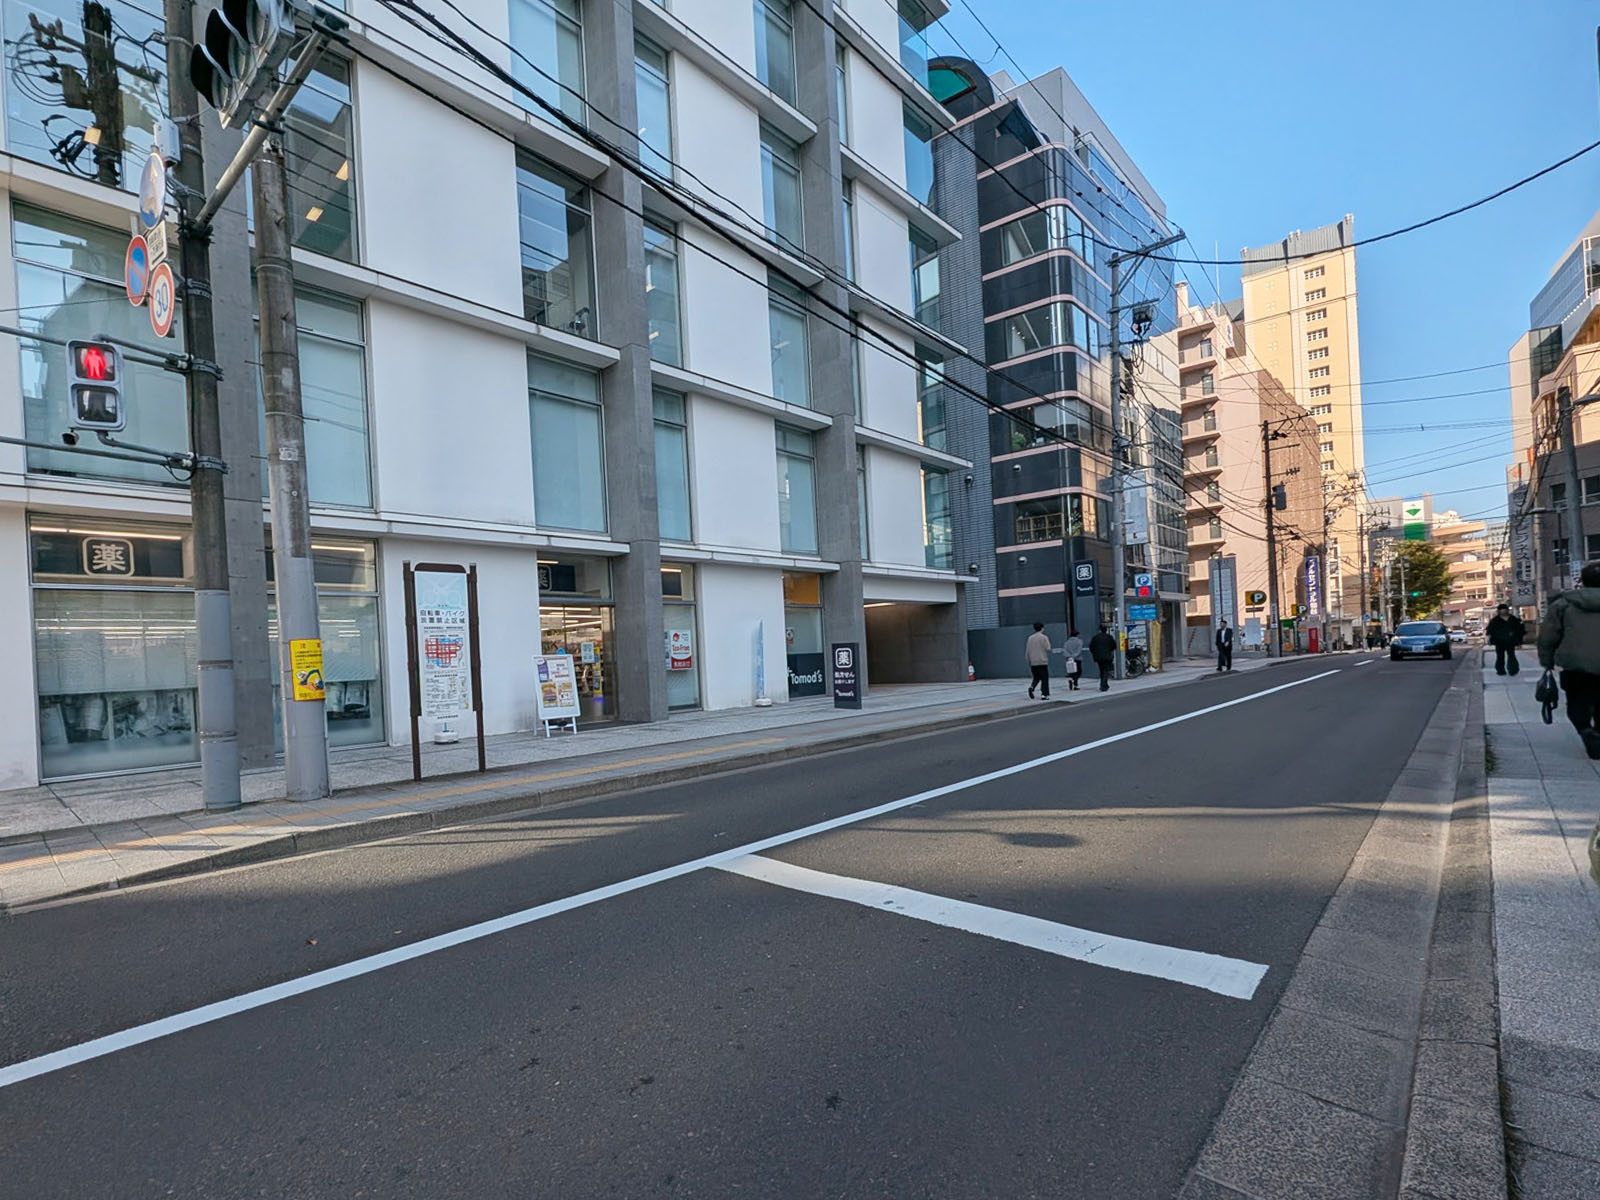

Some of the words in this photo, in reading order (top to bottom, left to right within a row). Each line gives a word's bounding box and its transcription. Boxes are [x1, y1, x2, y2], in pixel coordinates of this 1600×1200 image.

[155, 282, 168, 318] 30
[92, 544, 126, 571] 薬
[1254, 593, 1263, 603] P
[1298, 605, 1307, 614] P
[838, 651, 849, 664] 薬
[790, 670, 823, 684] Tomod's
